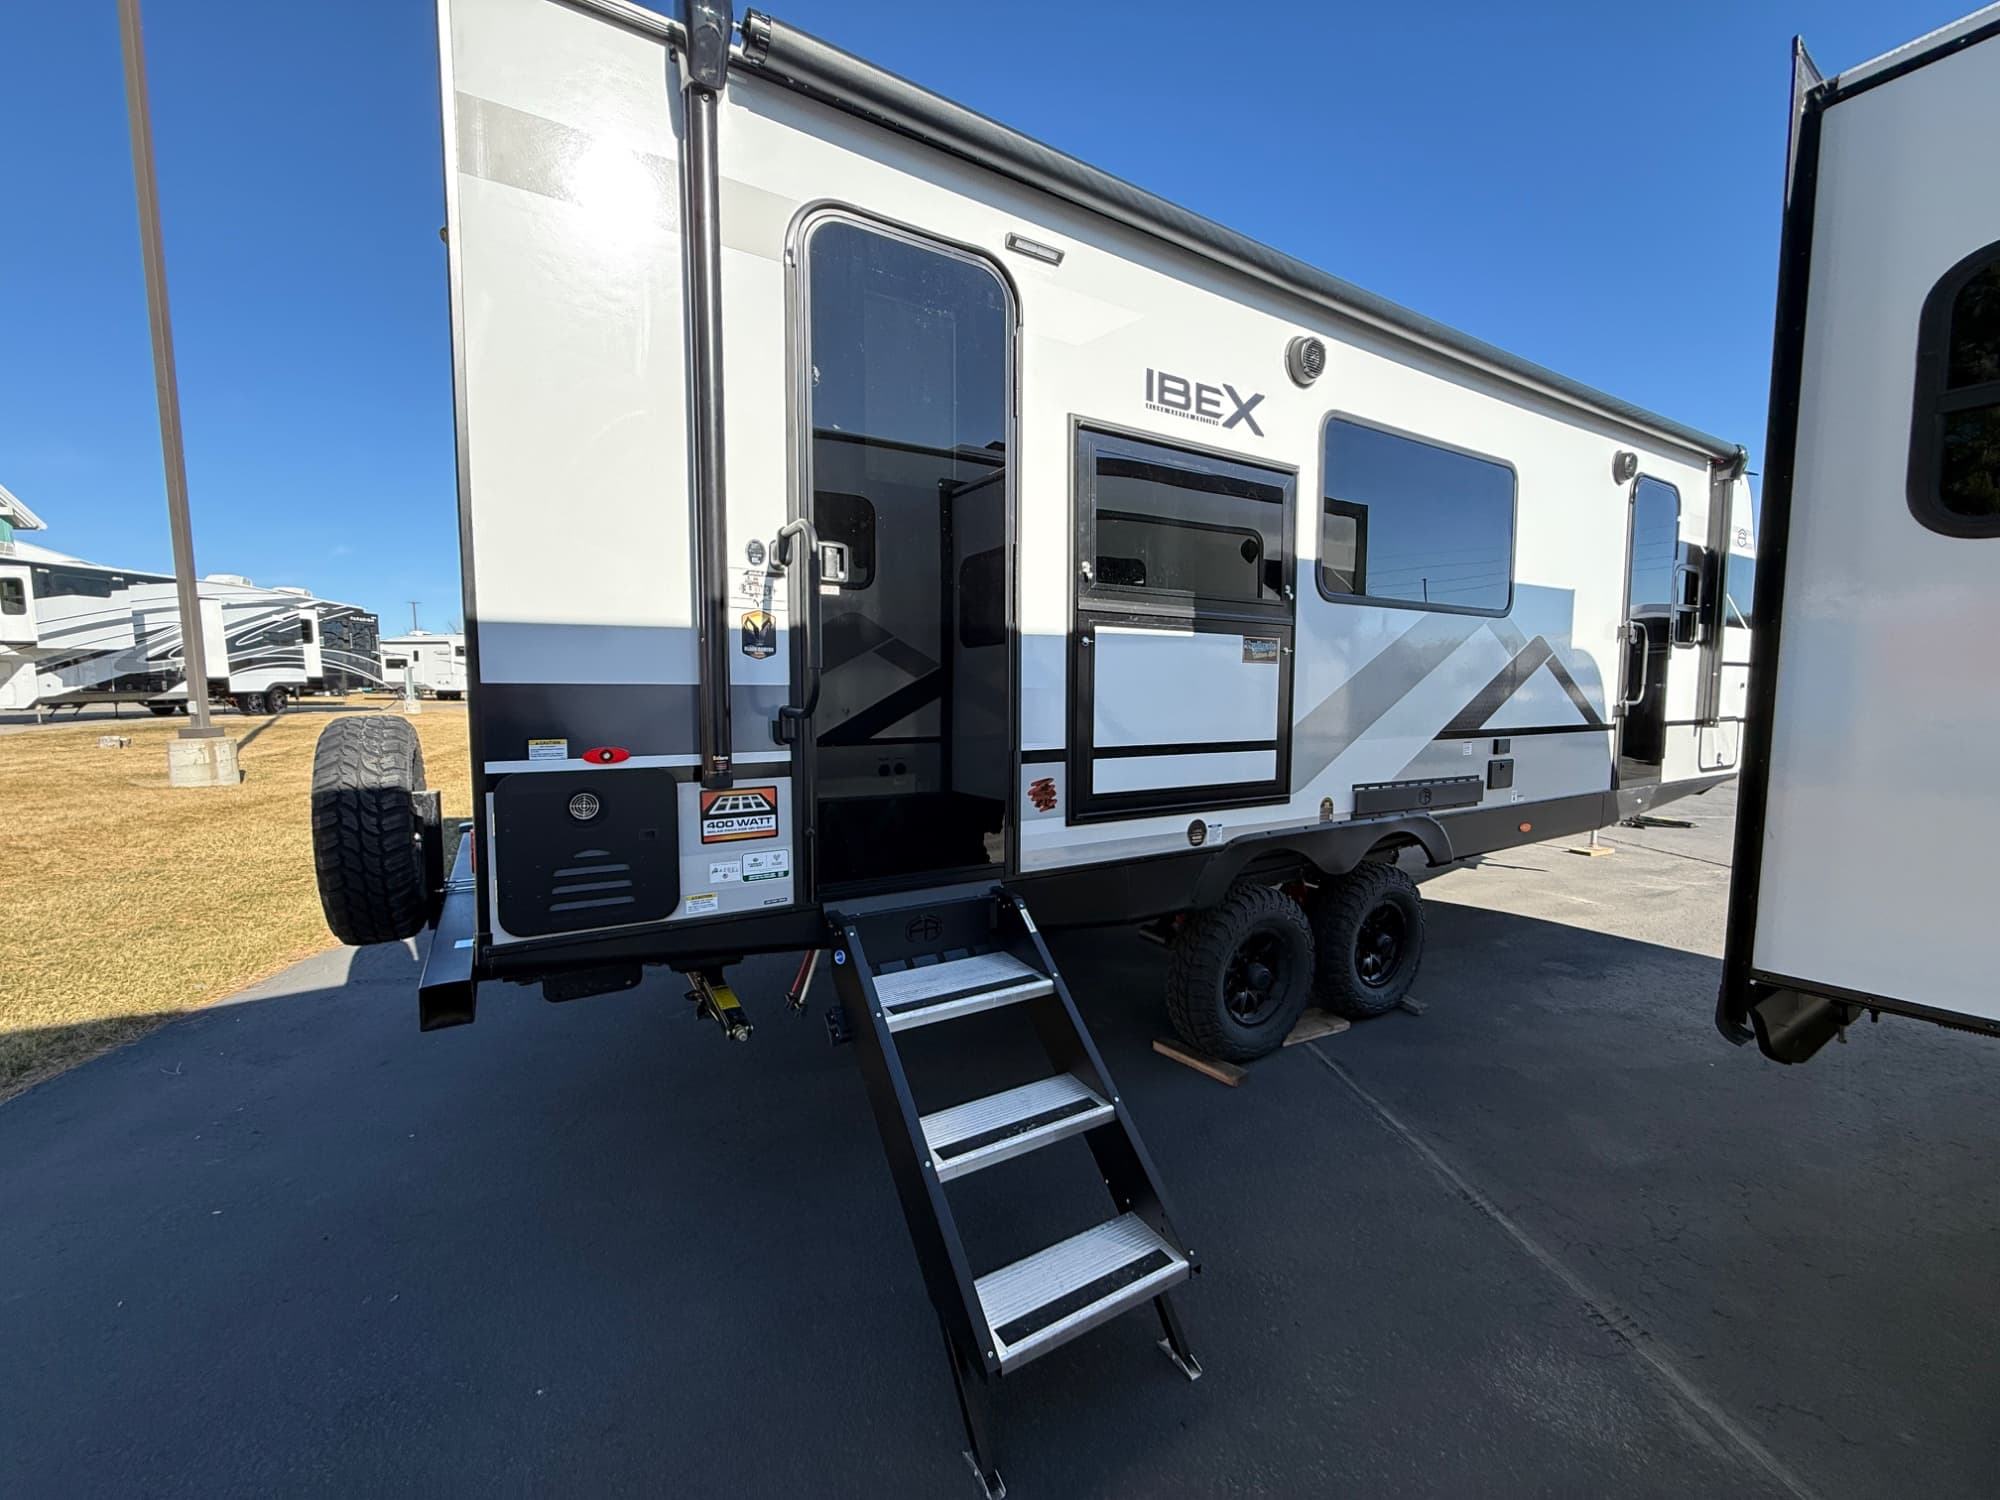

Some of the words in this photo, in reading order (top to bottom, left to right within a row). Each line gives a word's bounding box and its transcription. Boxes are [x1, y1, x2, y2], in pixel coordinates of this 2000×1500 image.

[1146, 367, 1265, 437] IBEX
[707, 820, 734, 829] 400
[736, 817, 770, 827] WATT
